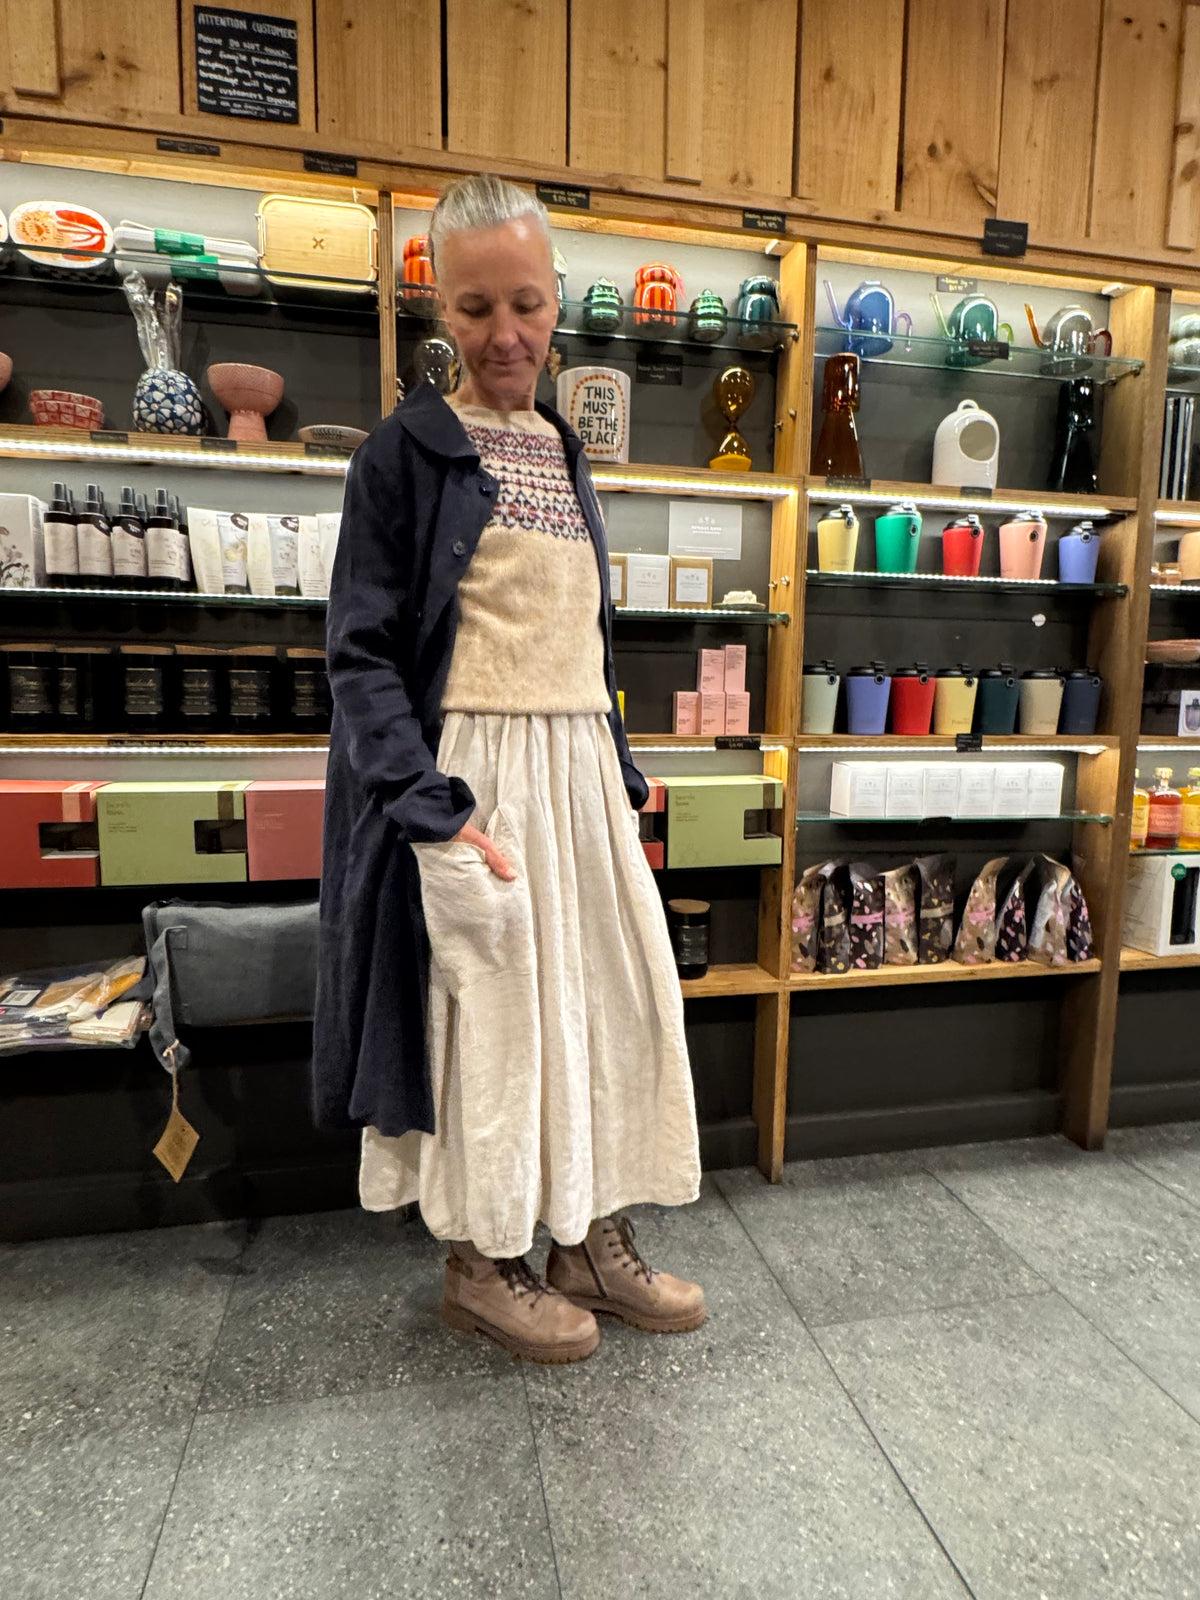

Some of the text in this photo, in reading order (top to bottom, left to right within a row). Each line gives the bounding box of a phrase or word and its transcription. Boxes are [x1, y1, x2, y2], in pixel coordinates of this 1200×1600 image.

[198, 13, 247, 31] ATTENTION
[584, 386, 615, 401] THIS
[583, 401, 616, 415] MUST
[578, 416, 618, 432] BE THE
[580, 430, 617, 445] PLACE
